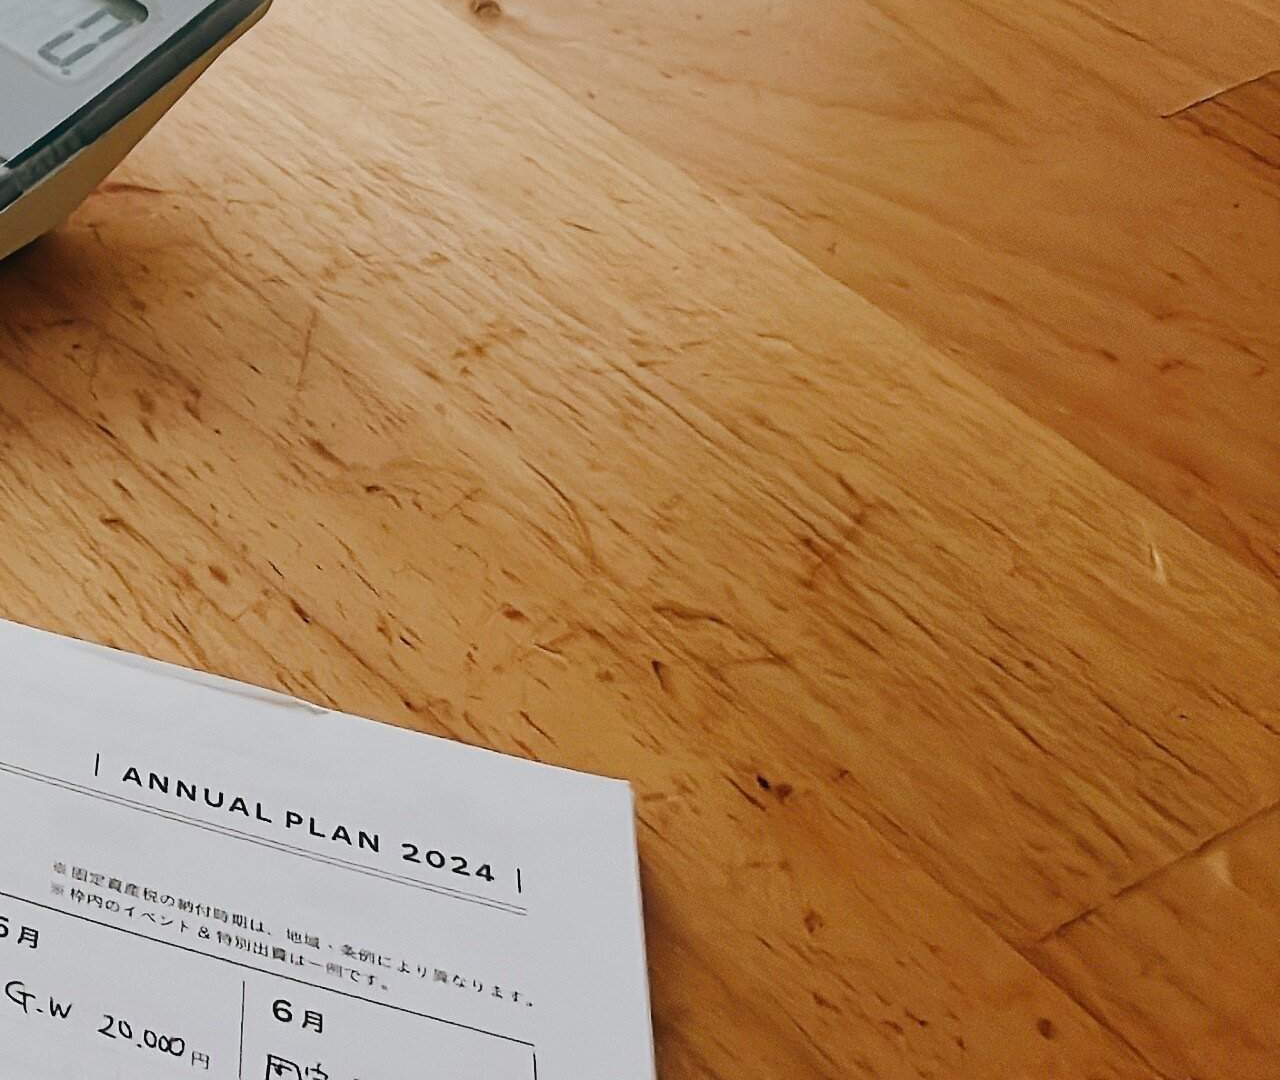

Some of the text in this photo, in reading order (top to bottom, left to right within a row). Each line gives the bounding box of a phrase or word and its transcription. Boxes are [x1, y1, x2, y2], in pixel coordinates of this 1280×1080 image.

[122, 765, 496, 884] ANNUAL PLAN 2024
[272, 999, 324, 1034] 6月
[191, 1051, 210, 1070] 円
